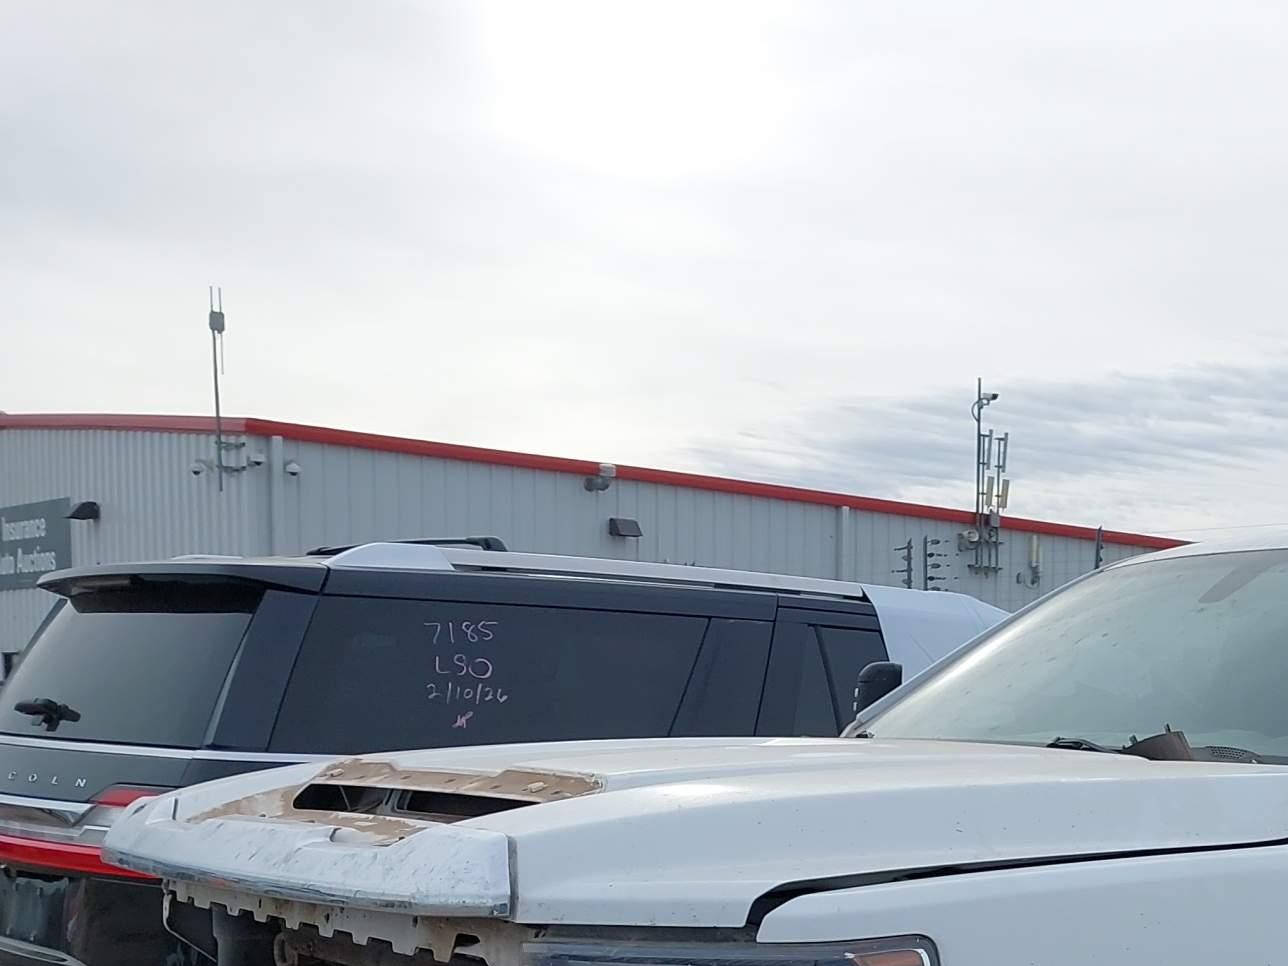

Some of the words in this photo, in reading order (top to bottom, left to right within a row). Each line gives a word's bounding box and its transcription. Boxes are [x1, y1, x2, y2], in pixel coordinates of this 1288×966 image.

[16, 546, 57, 574] Auctions
[423, 620, 499, 644] 7185
[426, 681, 508, 705] 2/10/26
